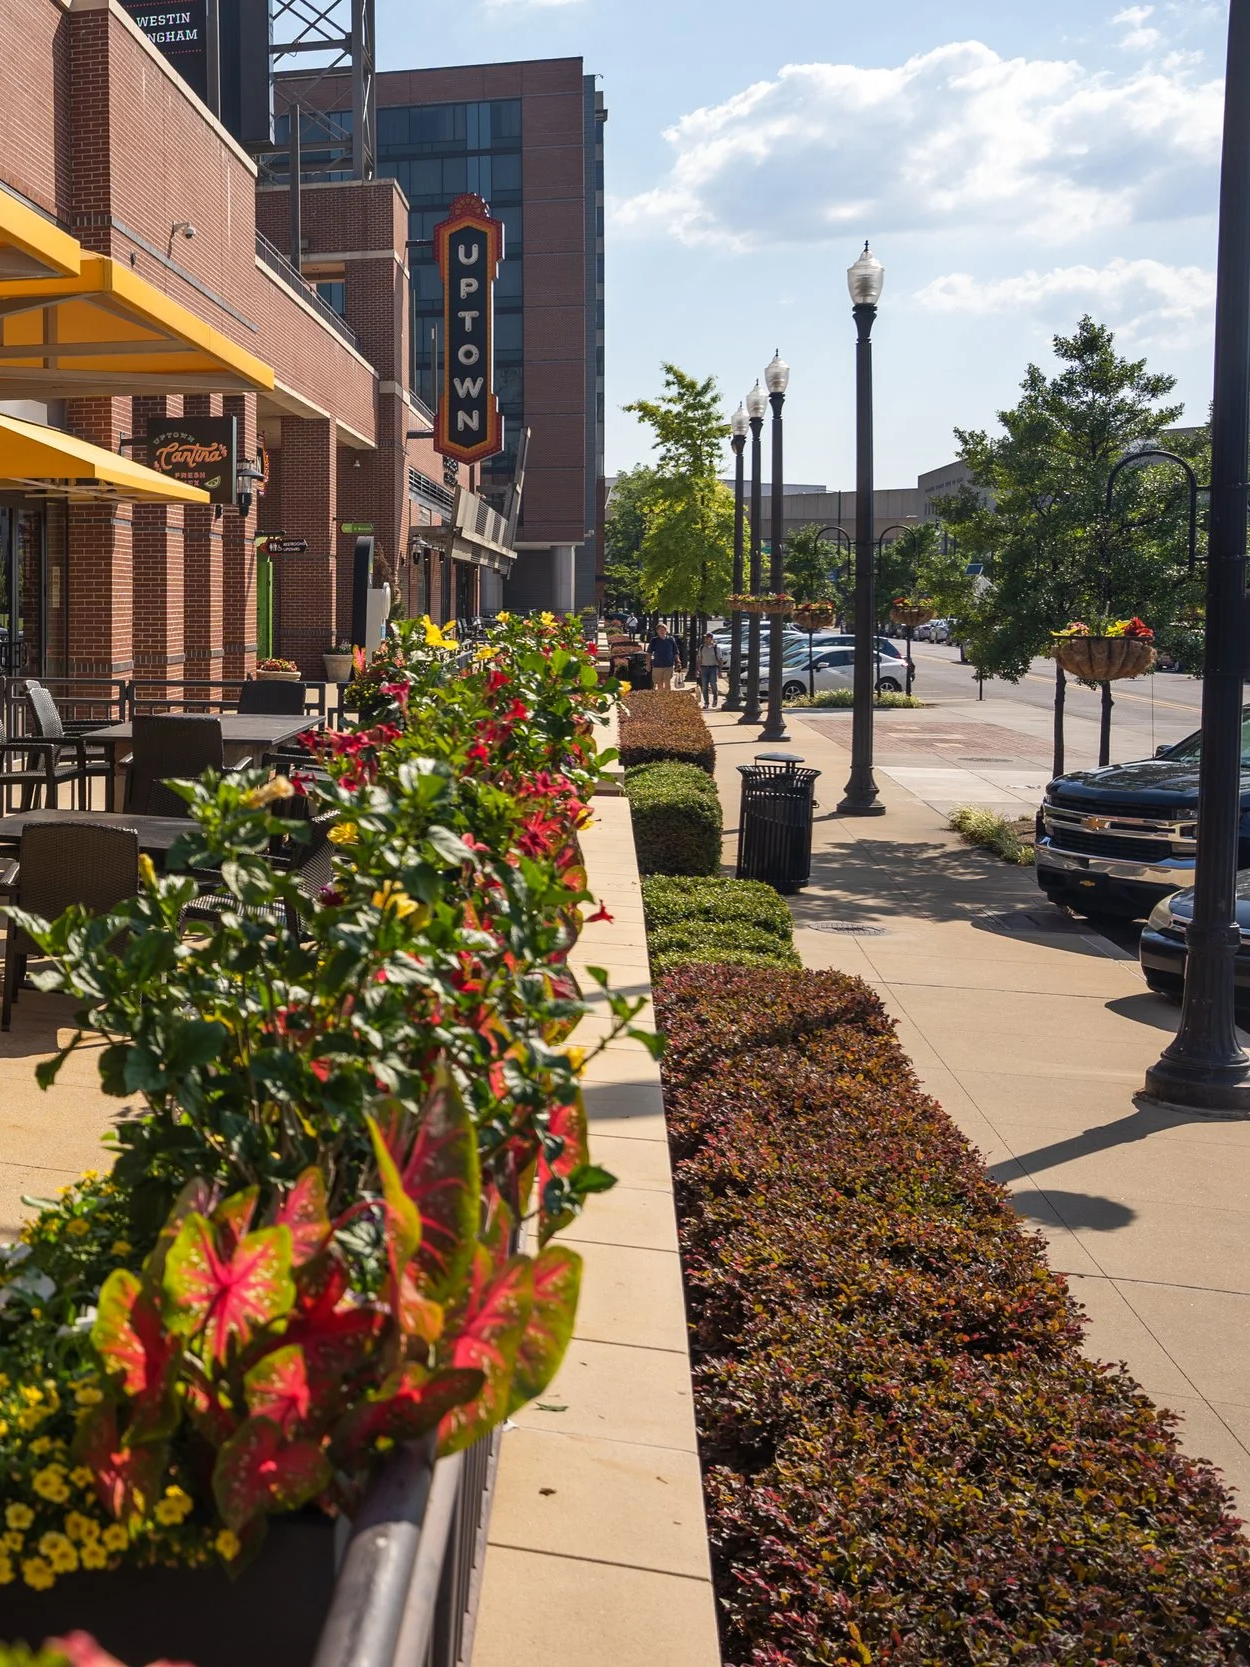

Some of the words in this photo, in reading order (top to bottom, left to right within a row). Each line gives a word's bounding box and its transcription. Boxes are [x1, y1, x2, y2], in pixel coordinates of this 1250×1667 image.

[136, 12, 191, 28] WESTIN
[453, 243, 484, 432] UPTOWN
[153, 432, 195, 444] UPTOWN
[156, 442, 222, 470] Cantina
